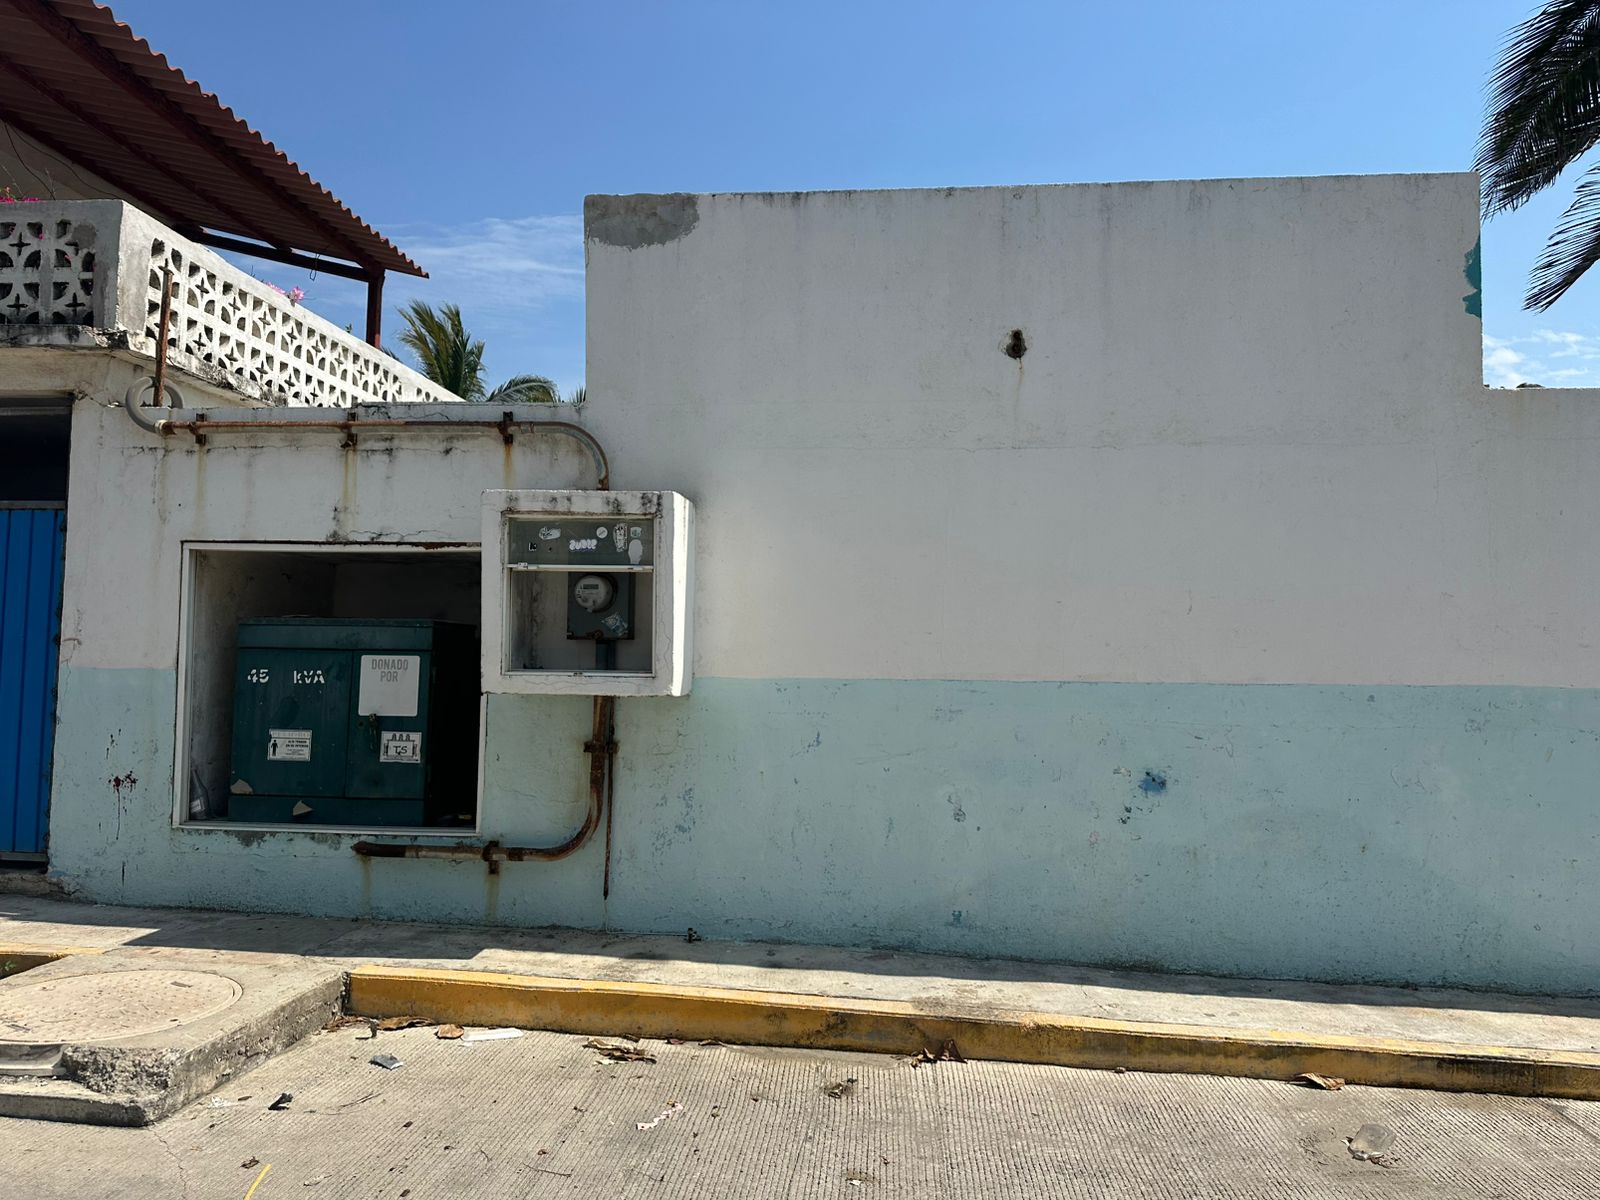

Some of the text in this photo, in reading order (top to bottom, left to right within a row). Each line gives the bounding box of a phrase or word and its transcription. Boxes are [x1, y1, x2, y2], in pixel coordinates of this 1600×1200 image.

[371, 658, 409, 670] DONADO
[247, 669, 270, 683] 45
[380, 670, 399, 682] POR
[393, 745, 408, 754] TS
